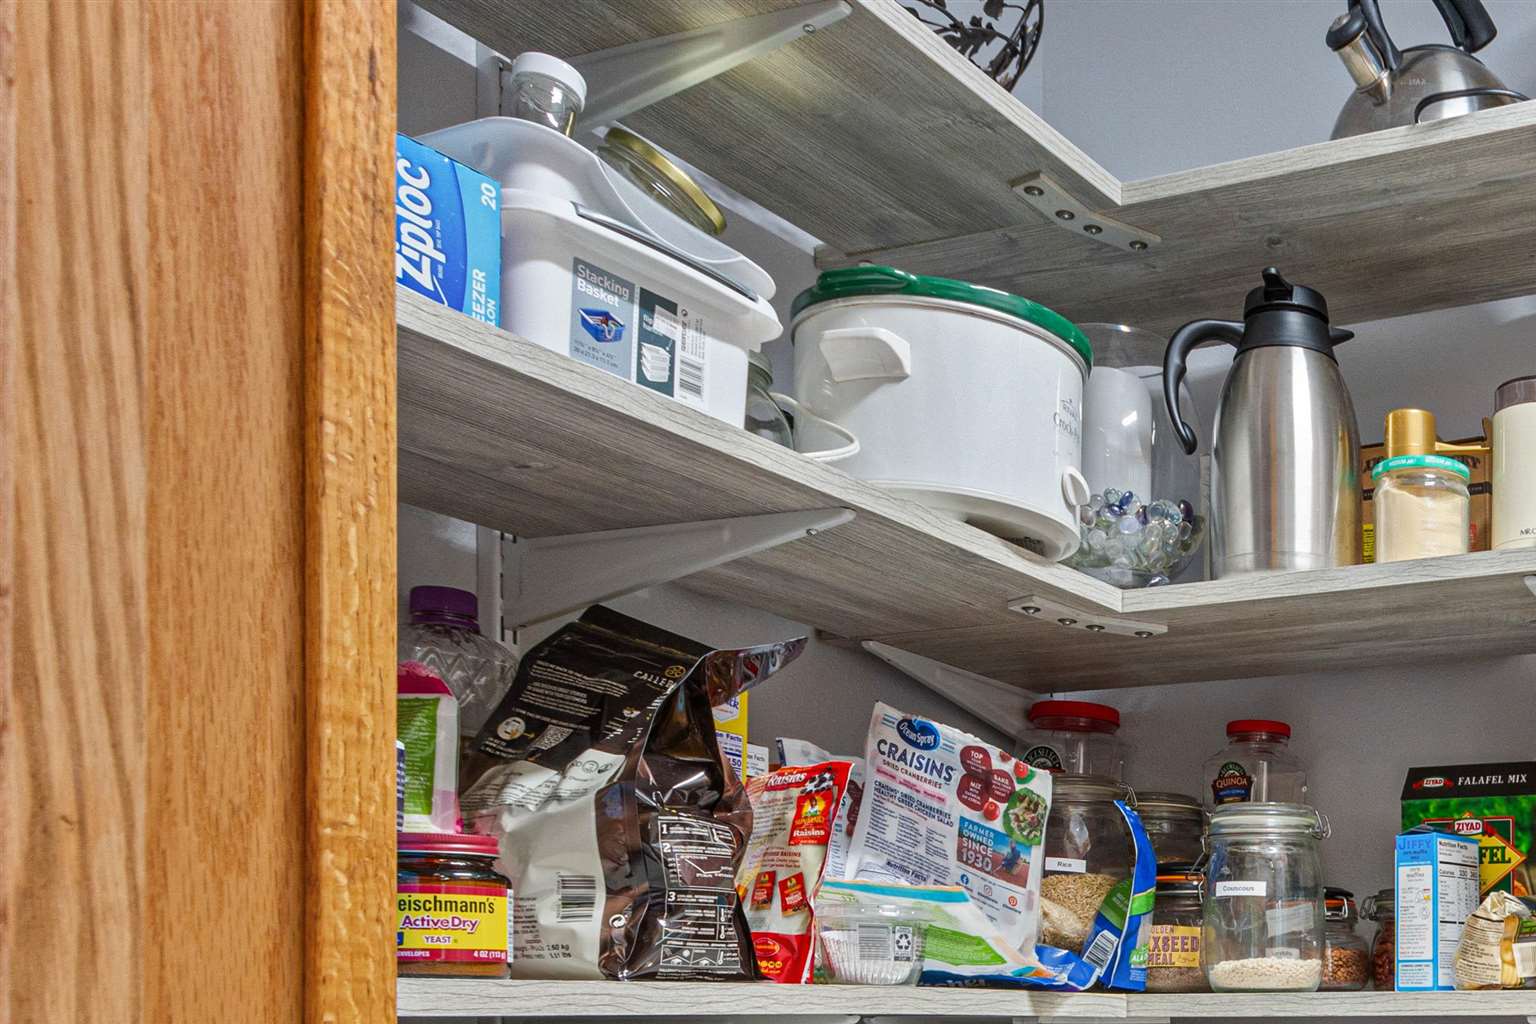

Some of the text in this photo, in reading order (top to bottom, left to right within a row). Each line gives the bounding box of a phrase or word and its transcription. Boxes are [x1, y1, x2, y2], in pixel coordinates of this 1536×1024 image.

[481, 182, 497, 211] 20
[395, 157, 447, 292] Ziploc
[577, 264, 630, 301] Stacking
[472, 268, 486, 325] EEZER
[577, 277, 620, 307] Basket
[633, 670, 676, 693] CALLEB
[899, 721, 936, 747] Ocean Spray
[877, 738, 954, 783] CRAISINS
[969, 750, 984, 760] TOP
[768, 772, 806, 786] Raisins
[900, 766, 943, 790] CRANBERRIES
[1216, 777, 1249, 788] QUINOA
[1458, 776, 1504, 786] FALAFEL
[1507, 774, 1527, 784] MIX
[661, 824, 669, 834] 1
[936, 812, 954, 828] SALAD
[1455, 821, 1482, 833] ZIYAD
[793, 828, 826, 838] Raisins
[962, 829, 994, 847] OWNED
[963, 821, 995, 839] FARMER
[663, 843, 672, 853] 2
[961, 838, 994, 858] SINCE
[961, 848, 993, 873] 1930
[397, 895, 496, 914] eischmann's
[668, 892, 677, 902] 3
[401, 915, 478, 933] Active Dry
[424, 935, 451, 944] YEAST
[1151, 936, 1200, 953] XSEED
